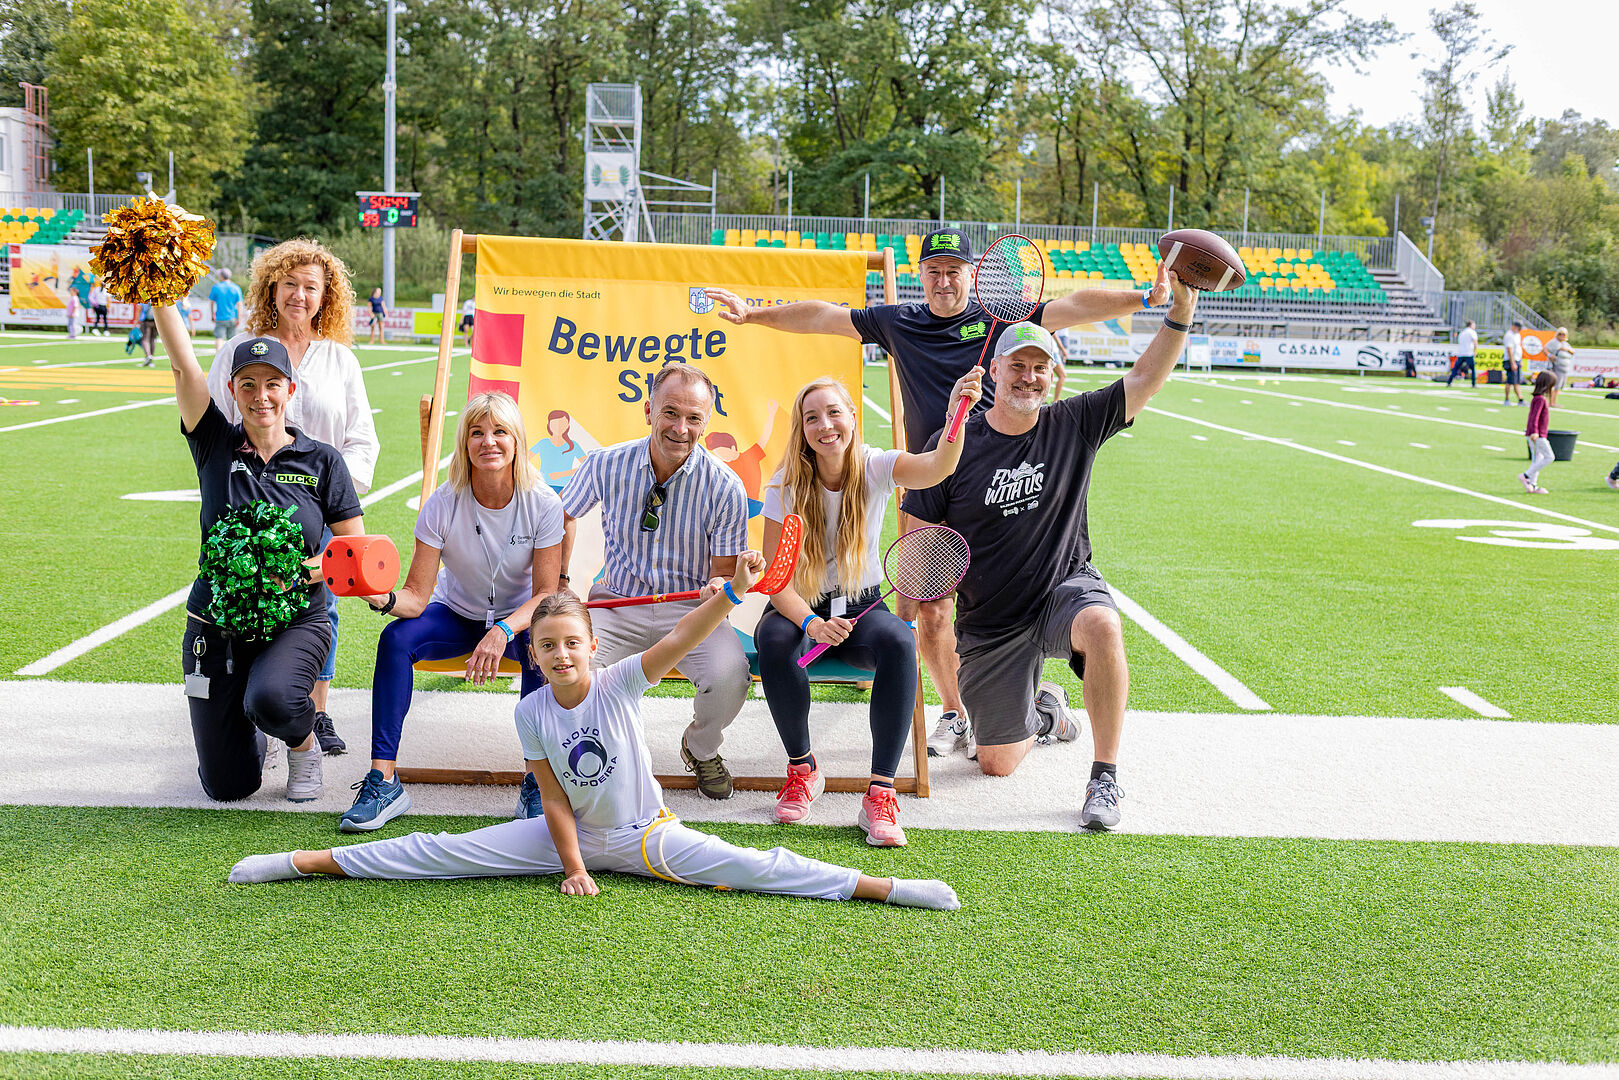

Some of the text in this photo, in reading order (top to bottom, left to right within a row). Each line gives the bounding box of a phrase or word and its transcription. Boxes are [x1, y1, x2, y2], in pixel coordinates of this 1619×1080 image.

[369, 195, 409, 210] 50:44
[493, 286, 601, 299] Wir bewegen die Stadt
[547, 316, 727, 368] Bewegte
[618, 369, 728, 417] Stt
[277, 475, 318, 485] DUCKS
[984, 482, 1024, 506] WITH
[1023, 472, 1044, 495] US
[561, 727, 601, 749] NOVO
[562, 755, 618, 788] CAPOEIRA
